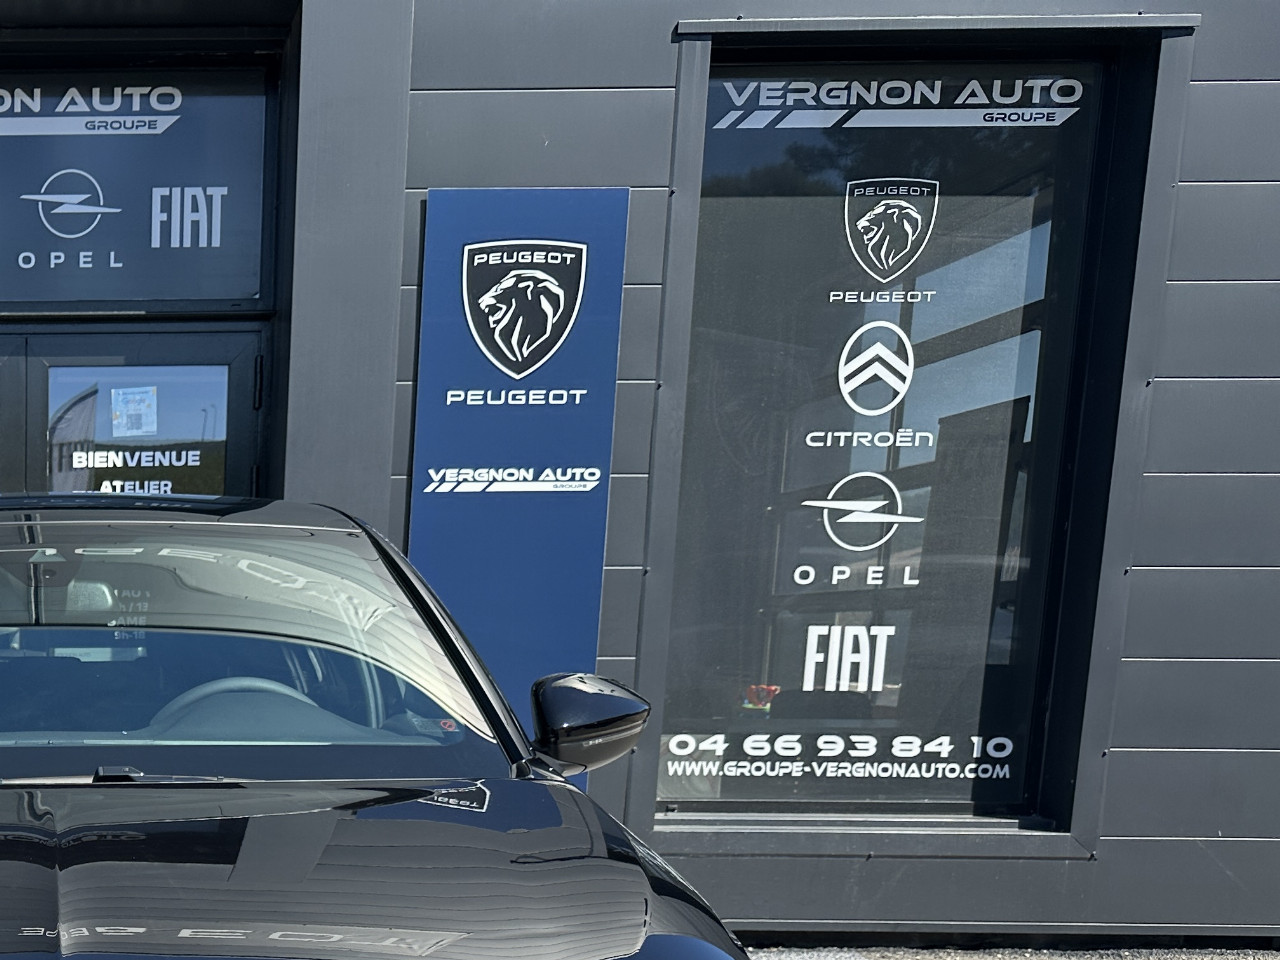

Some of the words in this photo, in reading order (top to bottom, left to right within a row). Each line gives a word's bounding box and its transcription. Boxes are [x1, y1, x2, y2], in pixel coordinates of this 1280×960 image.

[55, 87, 182, 112] AUTO
[723, 81, 941, 105] VERGNON
[954, 79, 1082, 104] AUTO
[85, 120, 158, 130] GROUPE
[983, 112, 1056, 122] GROUPE
[854, 187, 930, 197] PEUGEOT
[151, 187, 227, 248] FIAT
[19, 252, 122, 268] OPEL
[474, 252, 575, 266] PEUGEOT
[830, 291, 936, 302] PEUGEOT
[447, 390, 587, 405] PEUGEOT
[73, 449, 200, 468] BIENVENUE
[428, 468, 534, 481] VERGNON
[538, 468, 600, 480] AUTO
[100, 480, 173, 494] ATELIER
[794, 566, 919, 584] OPEL
[803, 626, 896, 692] FIAT
[669, 734, 729, 755] 04
[743, 735, 801, 756] 66
[817, 735, 877, 757] 93
[892, 736, 954, 757] 84
[971, 736, 1013, 758] 10
[667, 761, 1008, 779] WWW.GROUPE-VERGNONAUTO.COM
